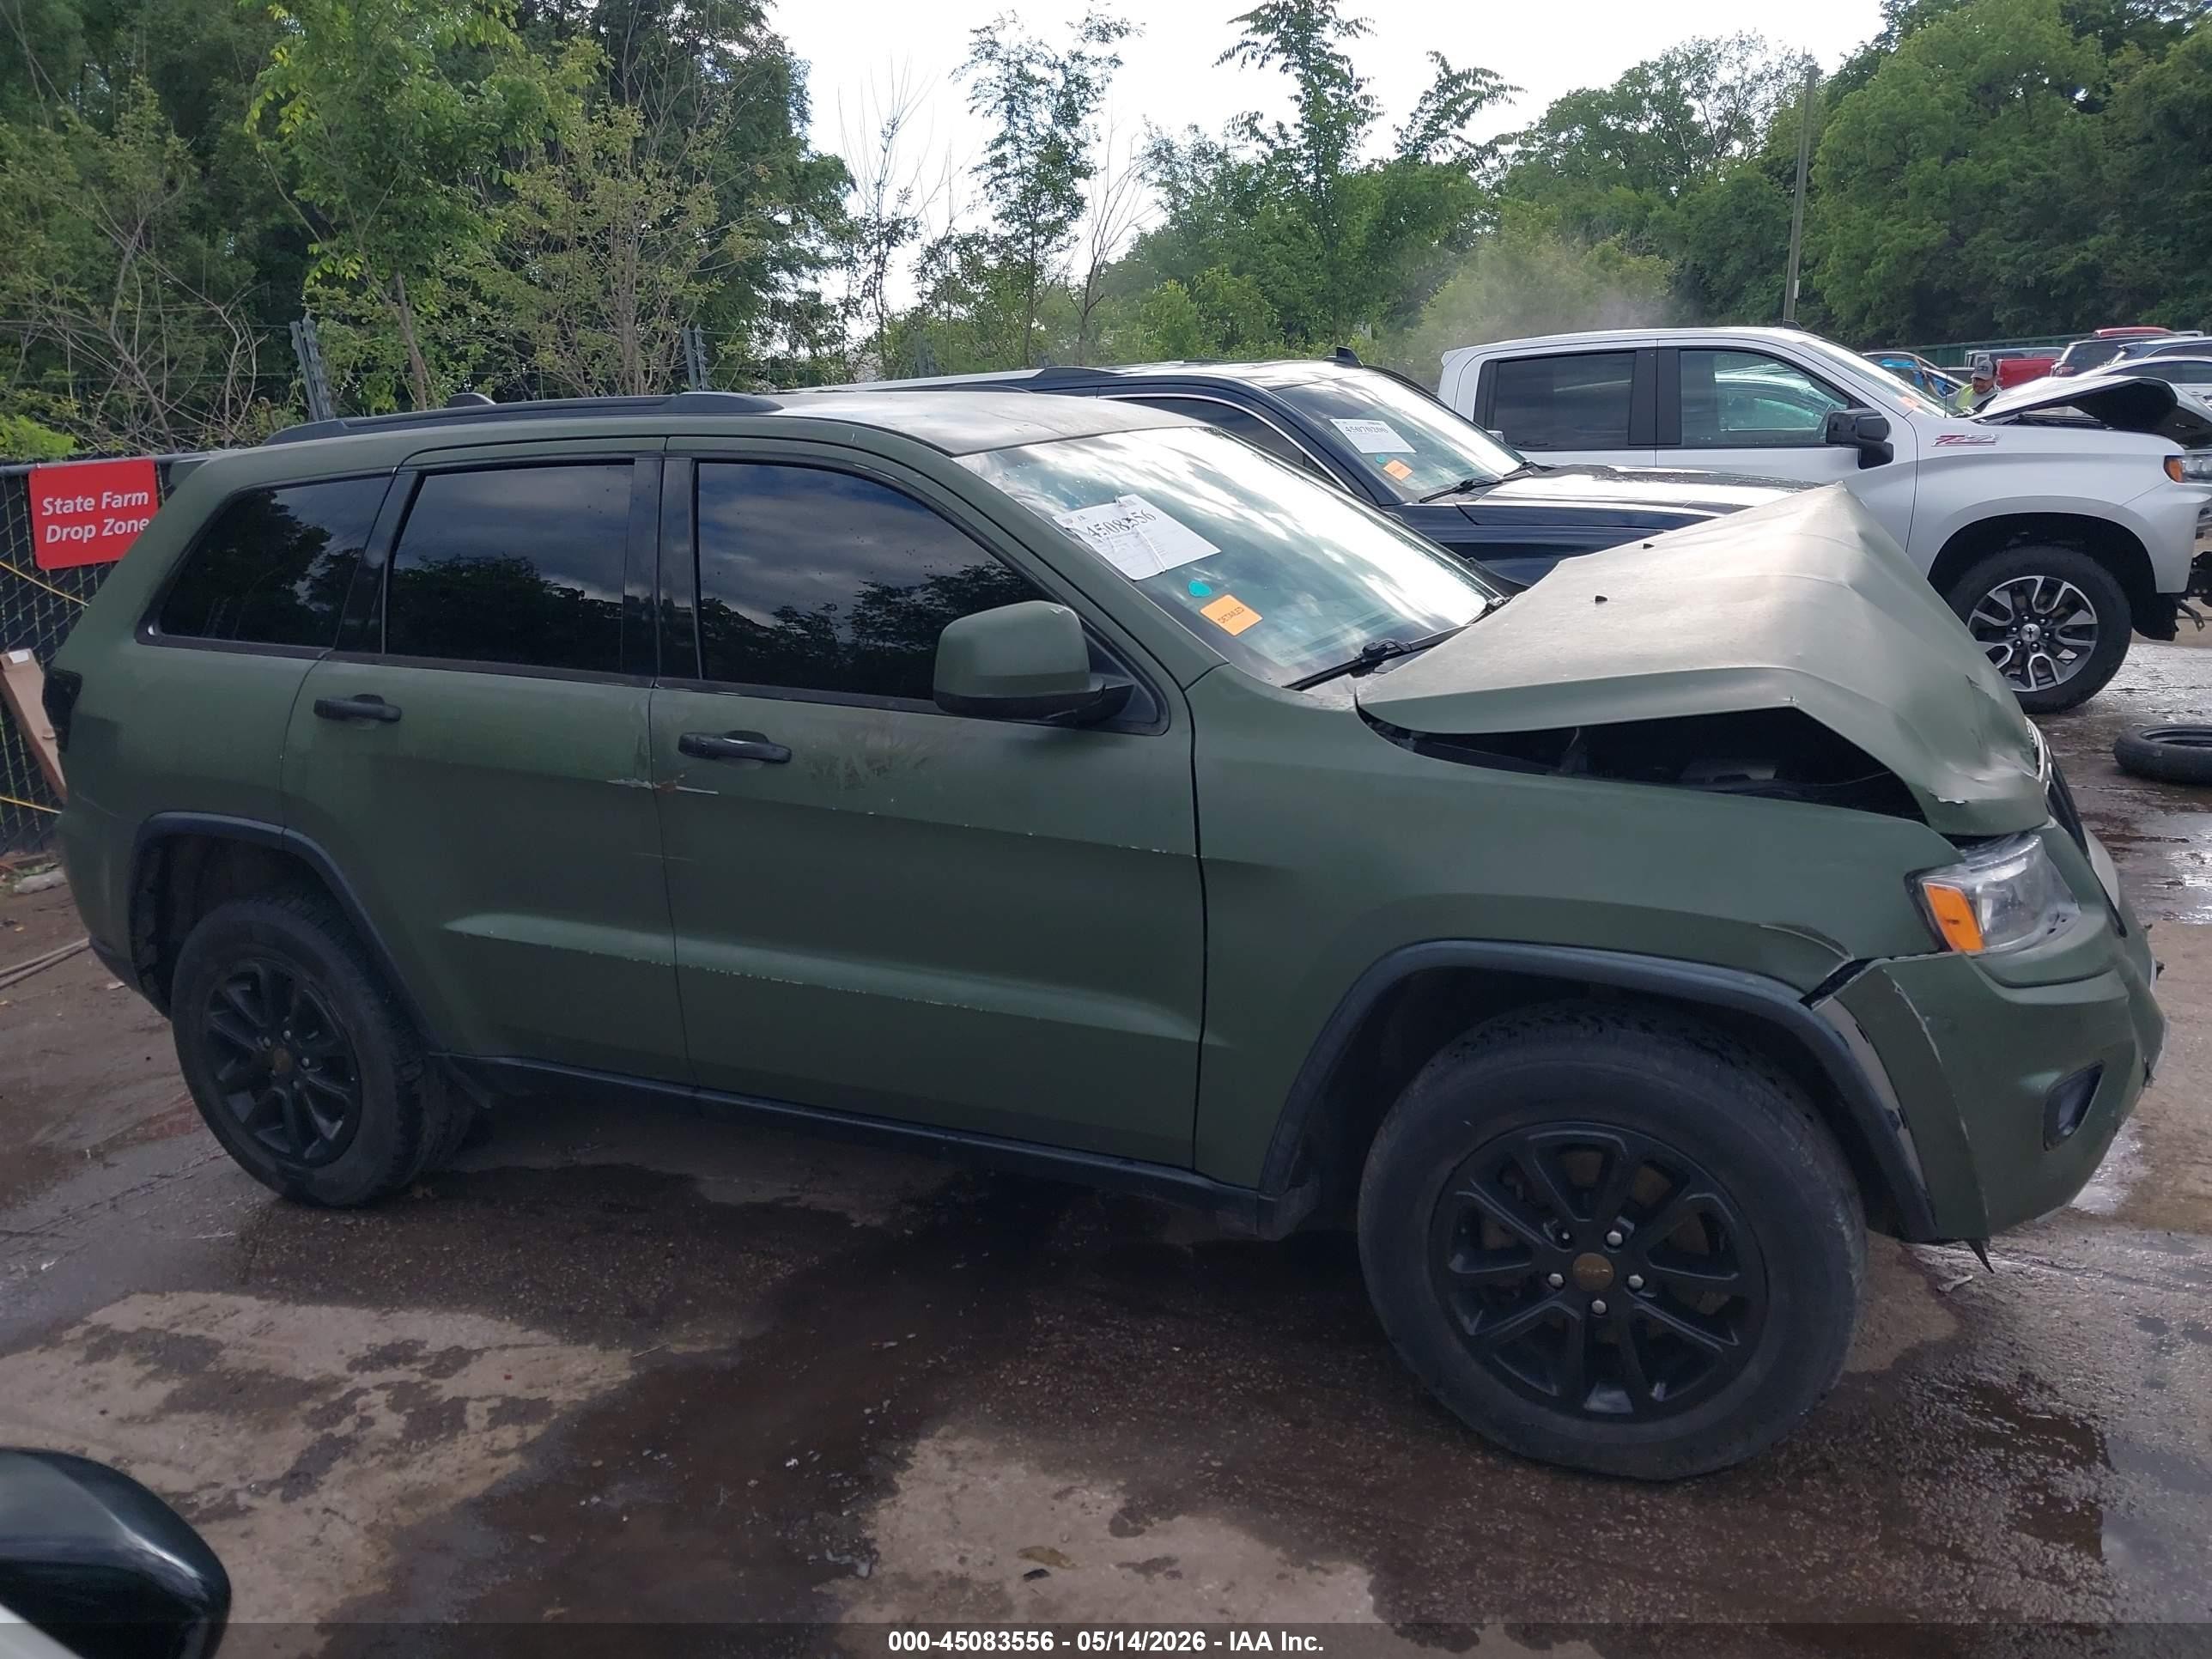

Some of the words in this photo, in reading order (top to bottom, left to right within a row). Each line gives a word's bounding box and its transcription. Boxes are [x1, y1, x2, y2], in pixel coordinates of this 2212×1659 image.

[41, 495, 95, 516] State
[101, 491, 149, 509] Farm
[46, 524, 96, 544] Drop
[101, 518, 150, 536] Zone
